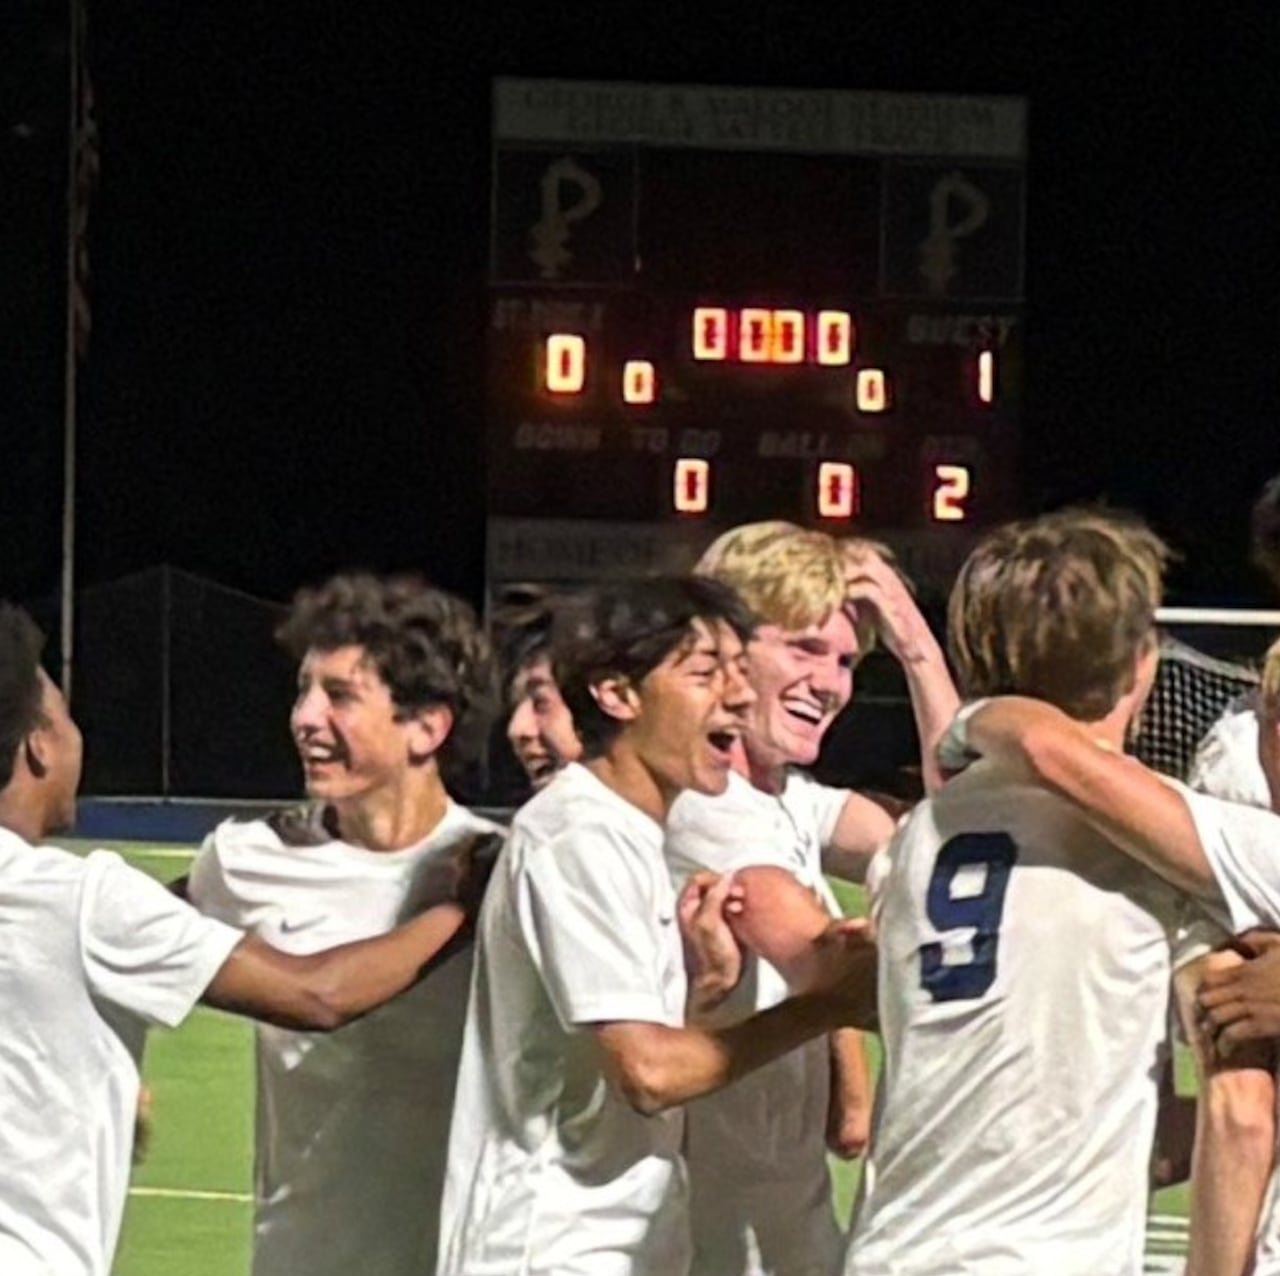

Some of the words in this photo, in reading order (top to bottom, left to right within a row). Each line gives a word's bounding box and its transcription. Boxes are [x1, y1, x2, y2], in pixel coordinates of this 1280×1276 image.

[546, 334, 585, 392] 0
[623, 361, 655, 403] 0
[979, 350, 993, 403] 1
[857, 369, 885, 411] 0
[675, 458, 709, 512] 0
[819, 462, 854, 517] 0
[934, 466, 969, 519] 2
[919, 832, 1018, 1003] 9
